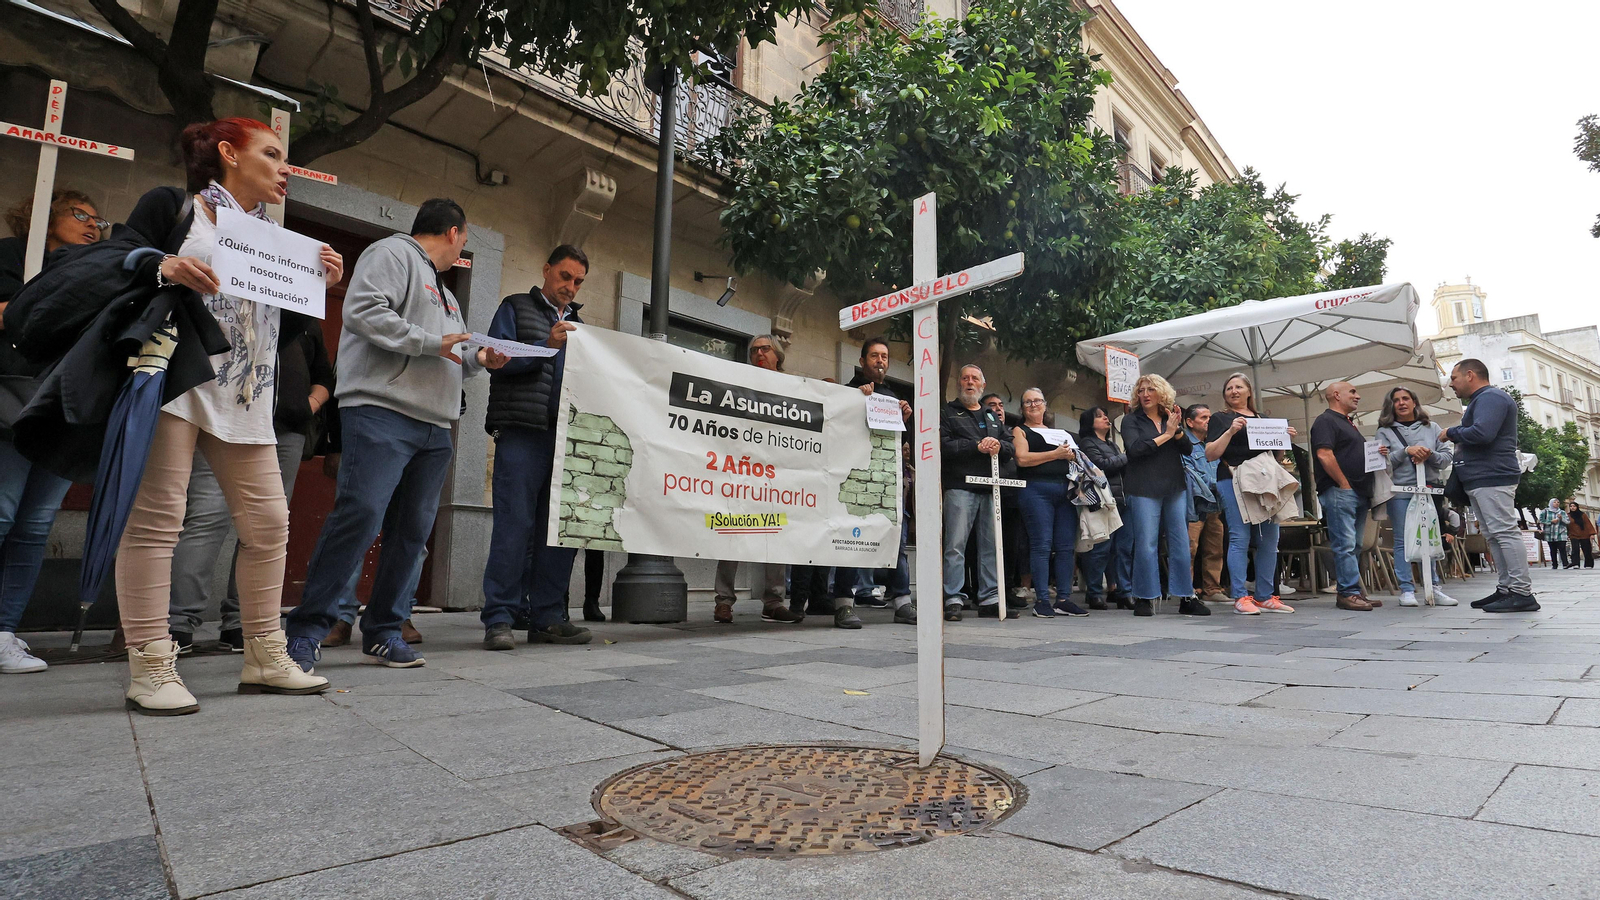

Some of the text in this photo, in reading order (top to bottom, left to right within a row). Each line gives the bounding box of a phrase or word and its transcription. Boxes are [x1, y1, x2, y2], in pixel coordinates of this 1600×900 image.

[7, 126, 119, 155] AMARGURA 2
[288, 166, 334, 182] SPERANZA
[380, 206, 395, 220] 14
[919, 201, 928, 215] A
[218, 236, 255, 256] ¿Quién
[258, 250, 276, 263] nos
[278, 255, 315, 275] informa
[250, 265, 293, 285] nosotros
[231, 276, 309, 306] De la situación?
[852, 272, 969, 322] DESCONSUELO
[917, 316, 934, 461] CALLE
[1113, 381, 1132, 395] ENGA
[686, 382, 812, 424] La Asunción
[668, 413, 822, 454] 70 Años de historia
[1255, 438, 1284, 447] fiscalía
[706, 451, 776, 479] 2 Años
[663, 472, 817, 508] para arruinarla
[1402, 486, 1443, 494] LORETO
[710, 512, 780, 530] ¡Solución YA!
